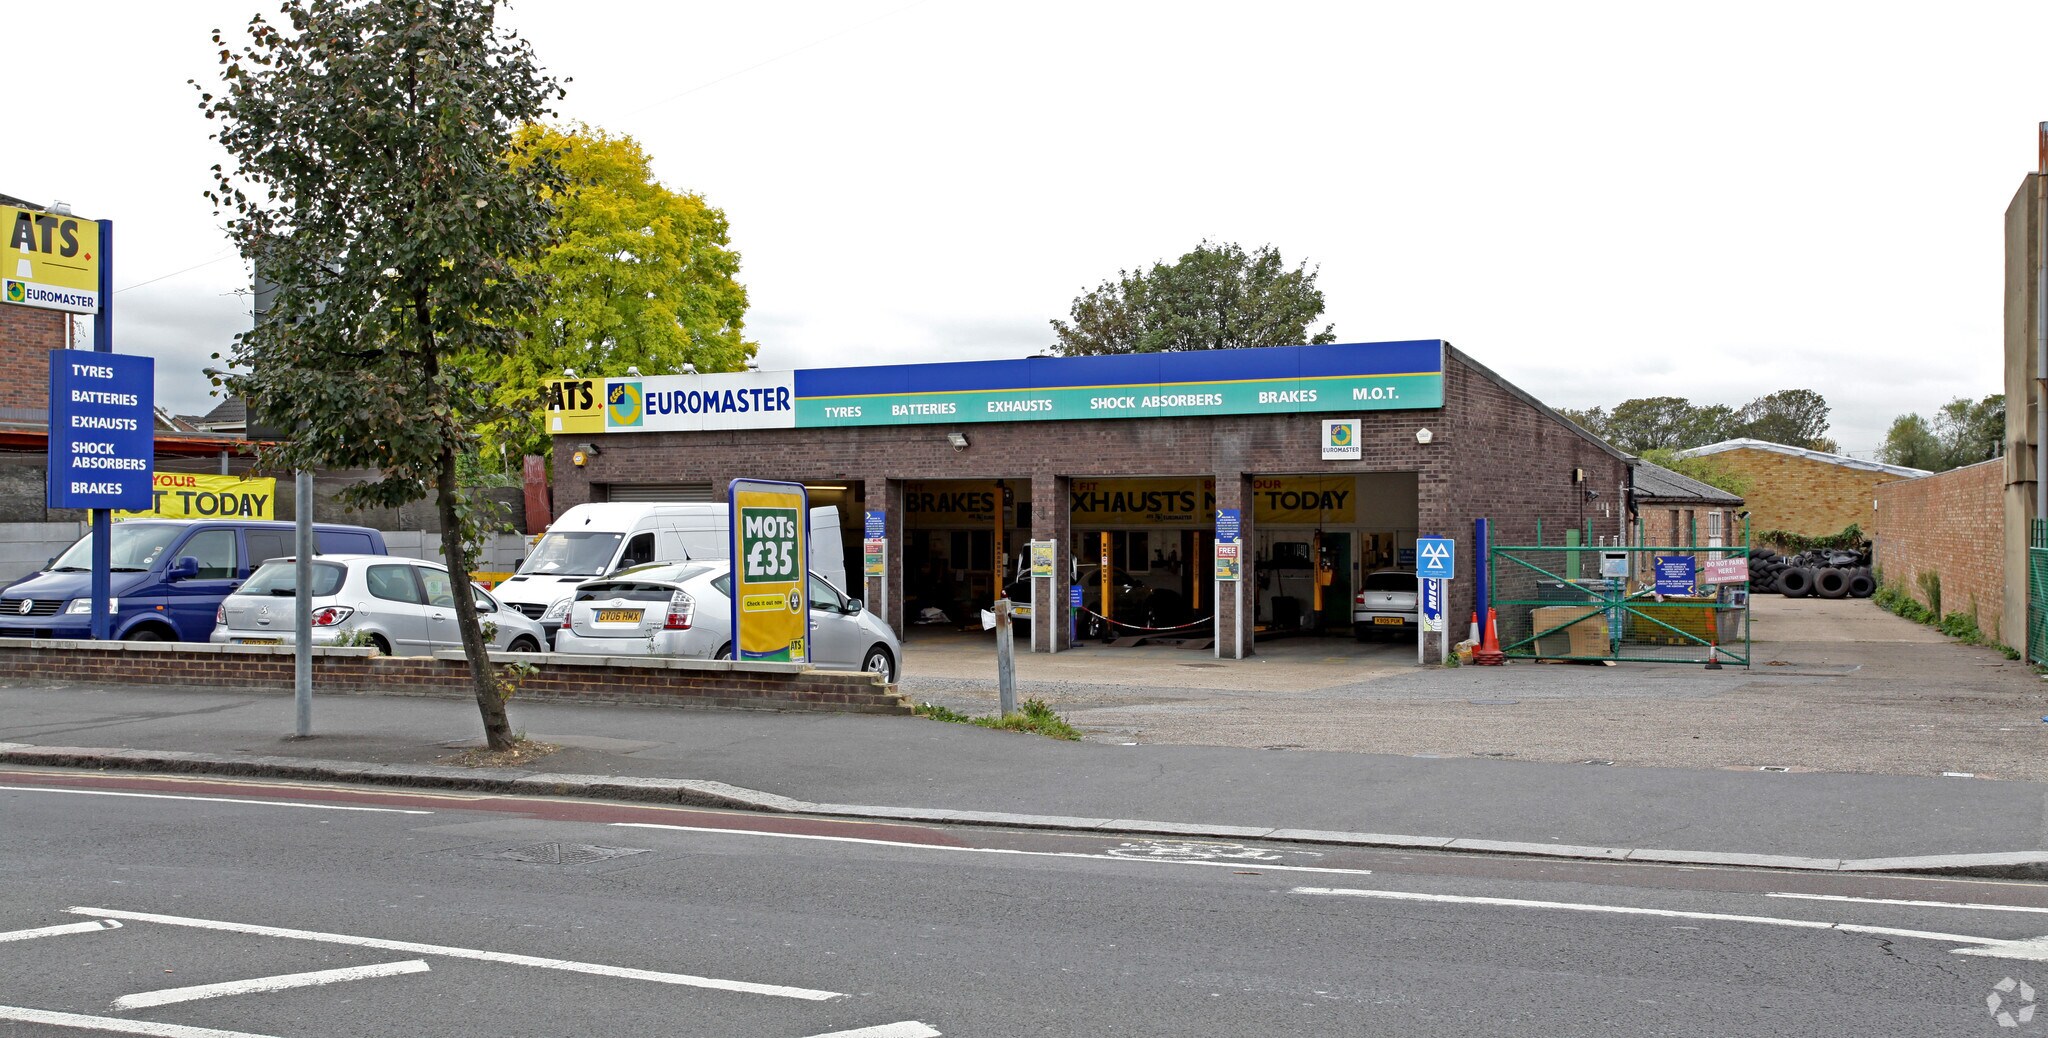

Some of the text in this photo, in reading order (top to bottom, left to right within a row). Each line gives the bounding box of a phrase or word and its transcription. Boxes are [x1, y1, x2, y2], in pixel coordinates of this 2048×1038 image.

[26, 288, 94, 308] EUROMASTER
[72, 364, 113, 379] TYRES
[72, 390, 137, 406] BATTERIES
[645, 386, 791, 415] EUROMASTER
[825, 386, 1399, 418] TYRES BATTERIES EXHAUSTS SHOCK ABSORBERS BRAKES M.O.T.
[72, 416, 137, 431] EXHAUSTS
[71, 441, 115, 455] SHOCK
[72, 456, 146, 470] ABSORBERS
[71, 482, 122, 495] BRAKES
[152, 474, 196, 488] YOUR
[1080, 482, 1098, 491] FIT
[1253, 480, 1281, 489] OUR
[176, 490, 268, 517] TODAY
[906, 492, 994, 513] BRAKES
[1071, 491, 1195, 512] XHAUSTS
[1265, 490, 1349, 510] TODAY
[1728, 558, 1744, 566] PARK
[600, 612, 639, 621] GV06 HMX
